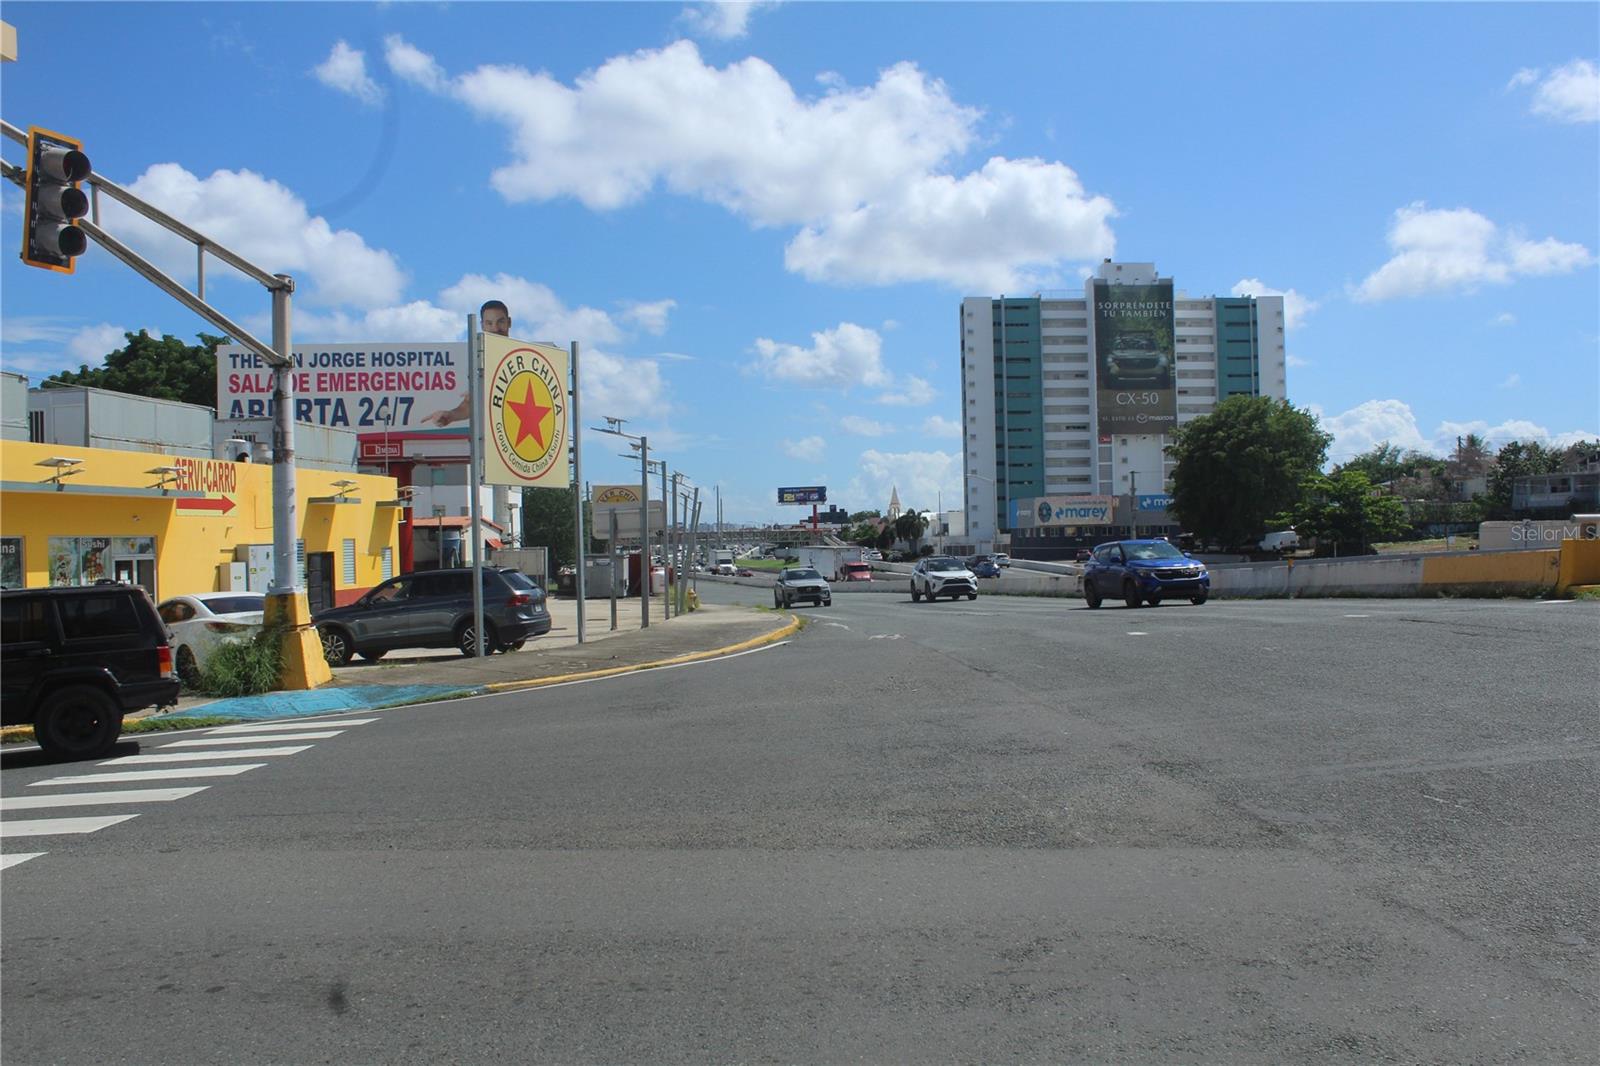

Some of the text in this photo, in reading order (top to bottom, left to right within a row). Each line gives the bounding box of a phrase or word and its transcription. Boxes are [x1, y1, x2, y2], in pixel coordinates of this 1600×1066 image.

[229, 354, 263, 368] THE
[308, 352, 366, 368] JORGE
[371, 351, 455, 367] HOSPITAL
[316, 371, 457, 393] EMERGENCIAS
[493, 355, 563, 416] RIVER CHINA
[1116, 392, 1159, 405] CX-50
[229, 396, 415, 427] ABIRTA 24/7
[175, 458, 237, 493] SERVI-CARRO
[1064, 506, 1108, 520] marey
